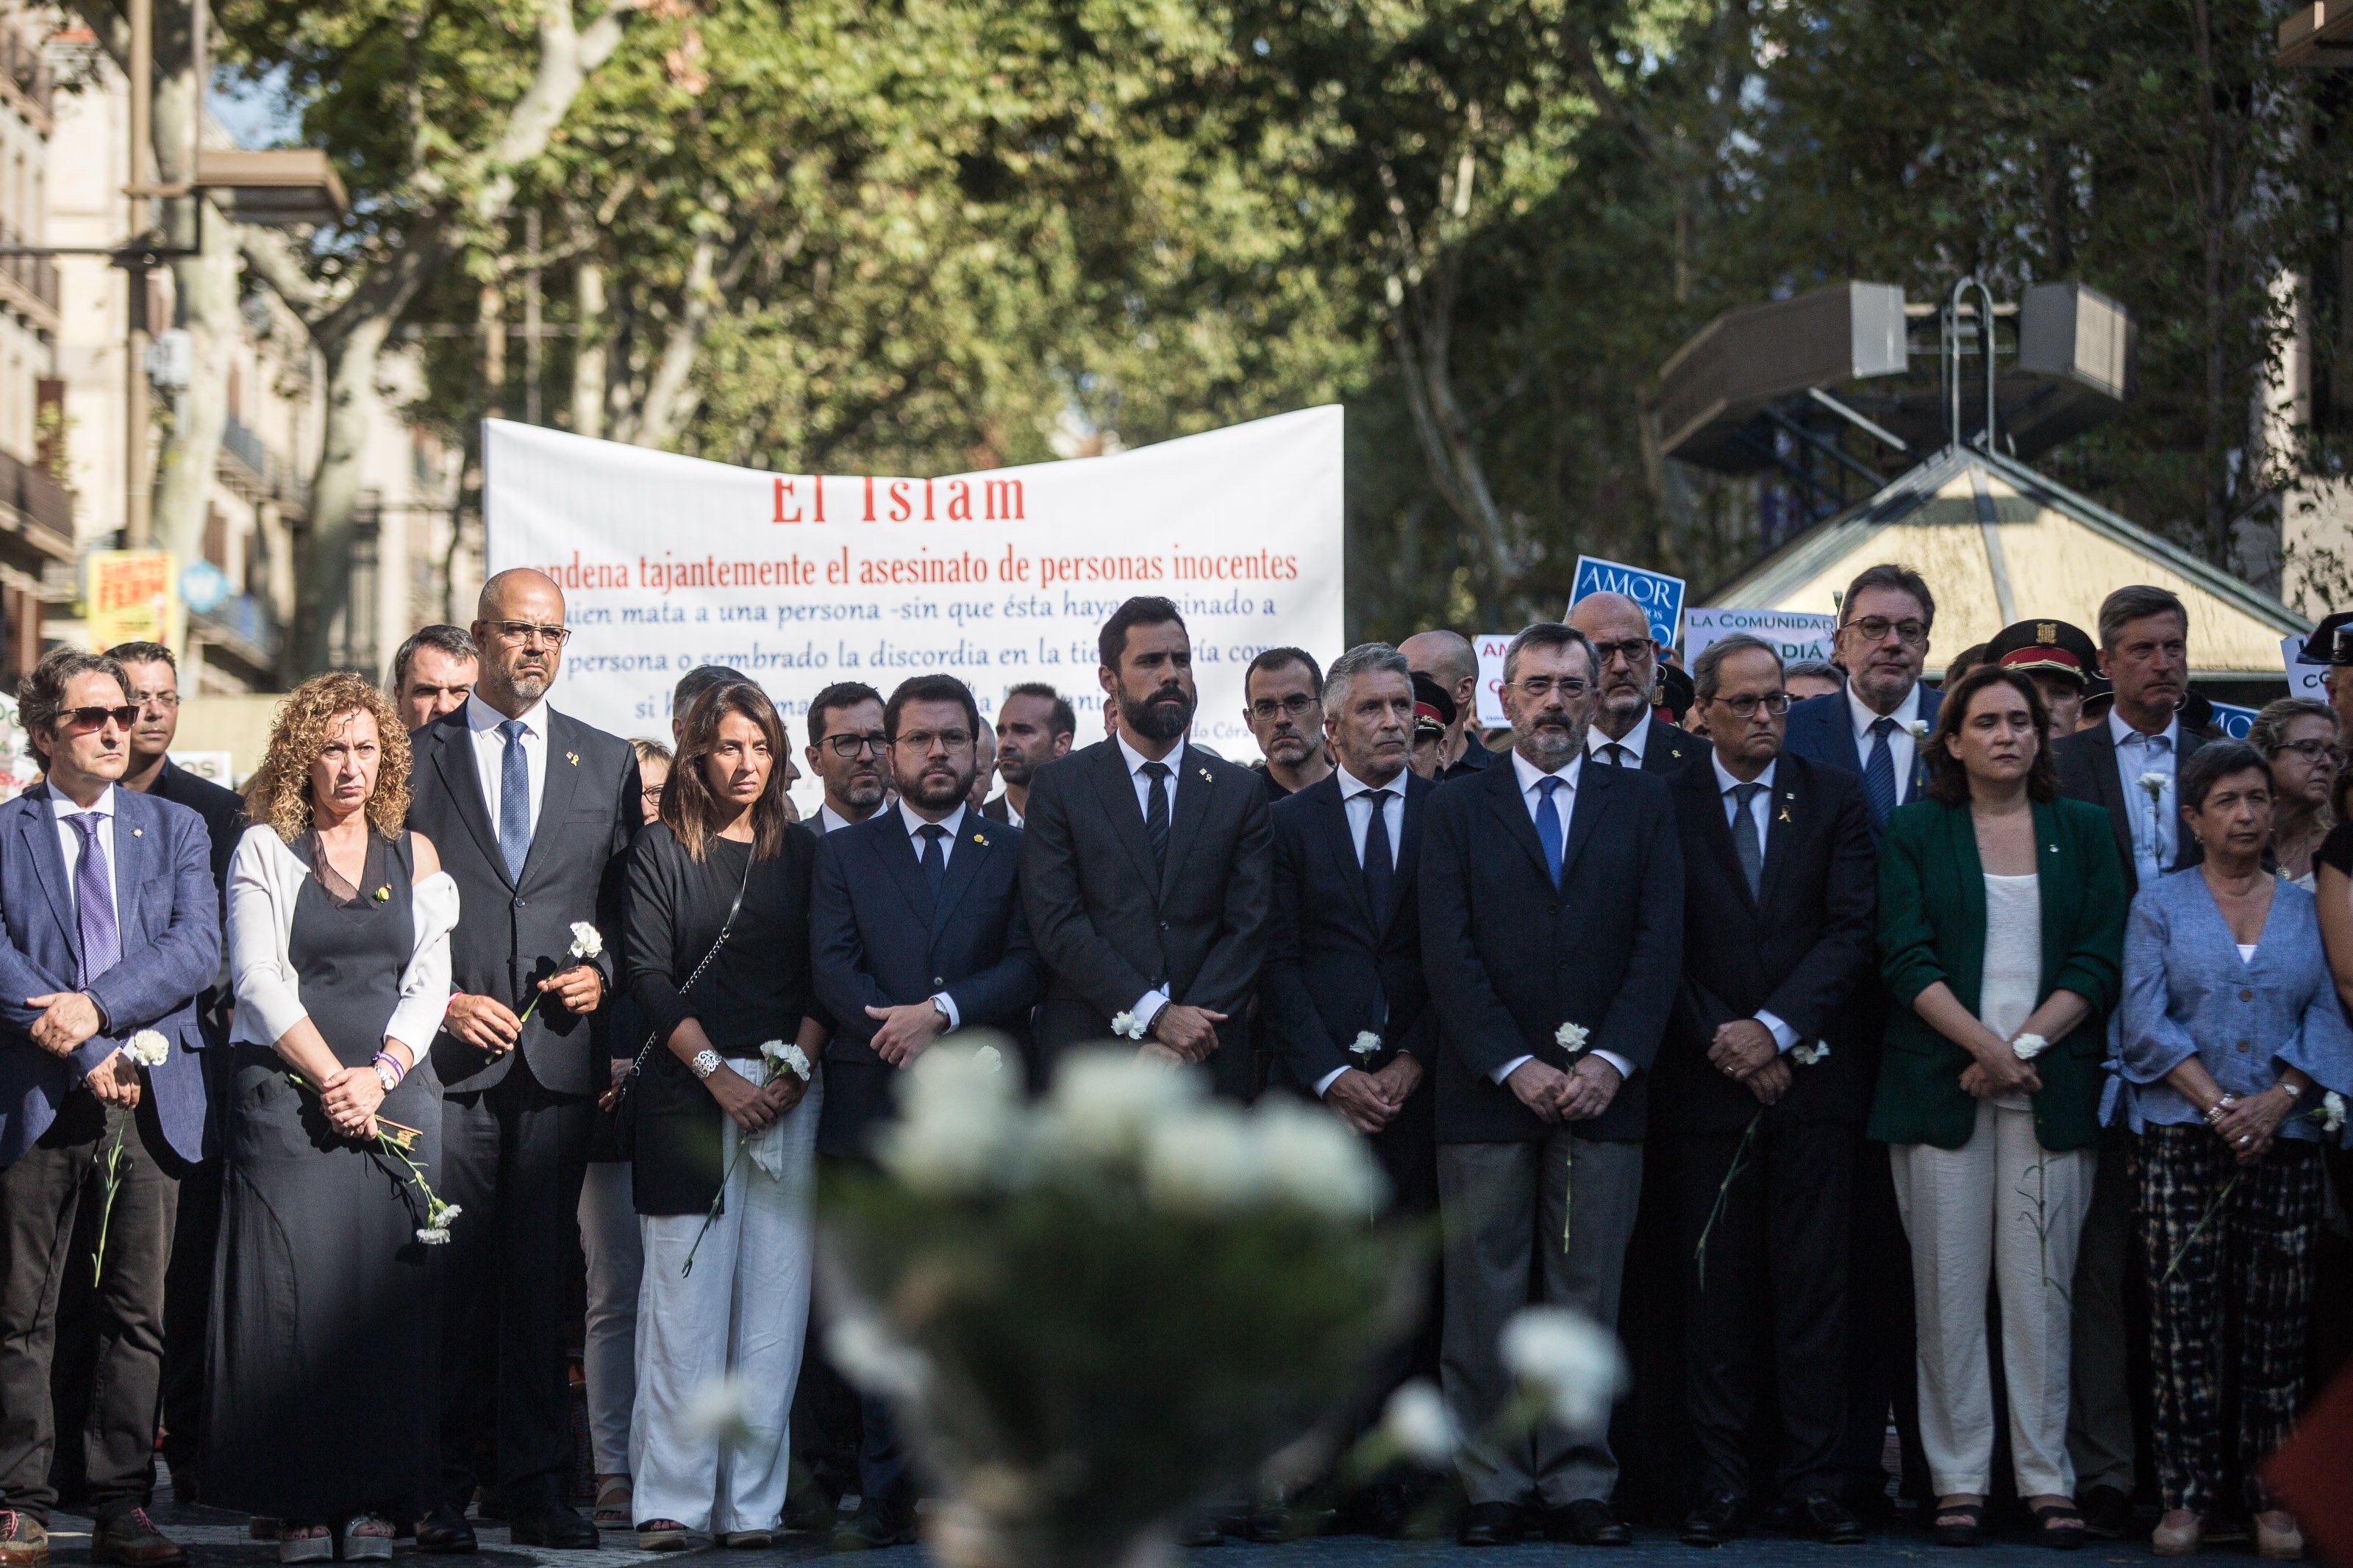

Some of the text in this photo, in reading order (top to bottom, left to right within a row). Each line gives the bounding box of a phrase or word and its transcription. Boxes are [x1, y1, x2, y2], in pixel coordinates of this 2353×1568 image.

[772, 475, 1025, 523] El Islam
[534, 543, 1298, 594] ndena tajantemente el asesinato de personas inocentes
[1581, 565, 1674, 610] AMOR
[622, 599, 686, 624] mata
[696, 606, 710, 623] a
[719, 604, 768, 623] una
[776, 602, 880, 629] persona
[889, 596, 939, 620] -sin
[948, 601, 994, 627] que
[1003, 593, 1054, 618] ésta
[1263, 598, 1277, 615] a
[1691, 615, 1713, 627] LA
[568, 650, 670, 680] persona
[677, 651, 691, 670] o
[700, 639, 829, 670] sembrado
[838, 638, 860, 667] la
[869, 637, 990, 668] discordia
[999, 647, 1029, 665] en
[1038, 637, 1060, 665] la
[635, 695, 655, 719] si
